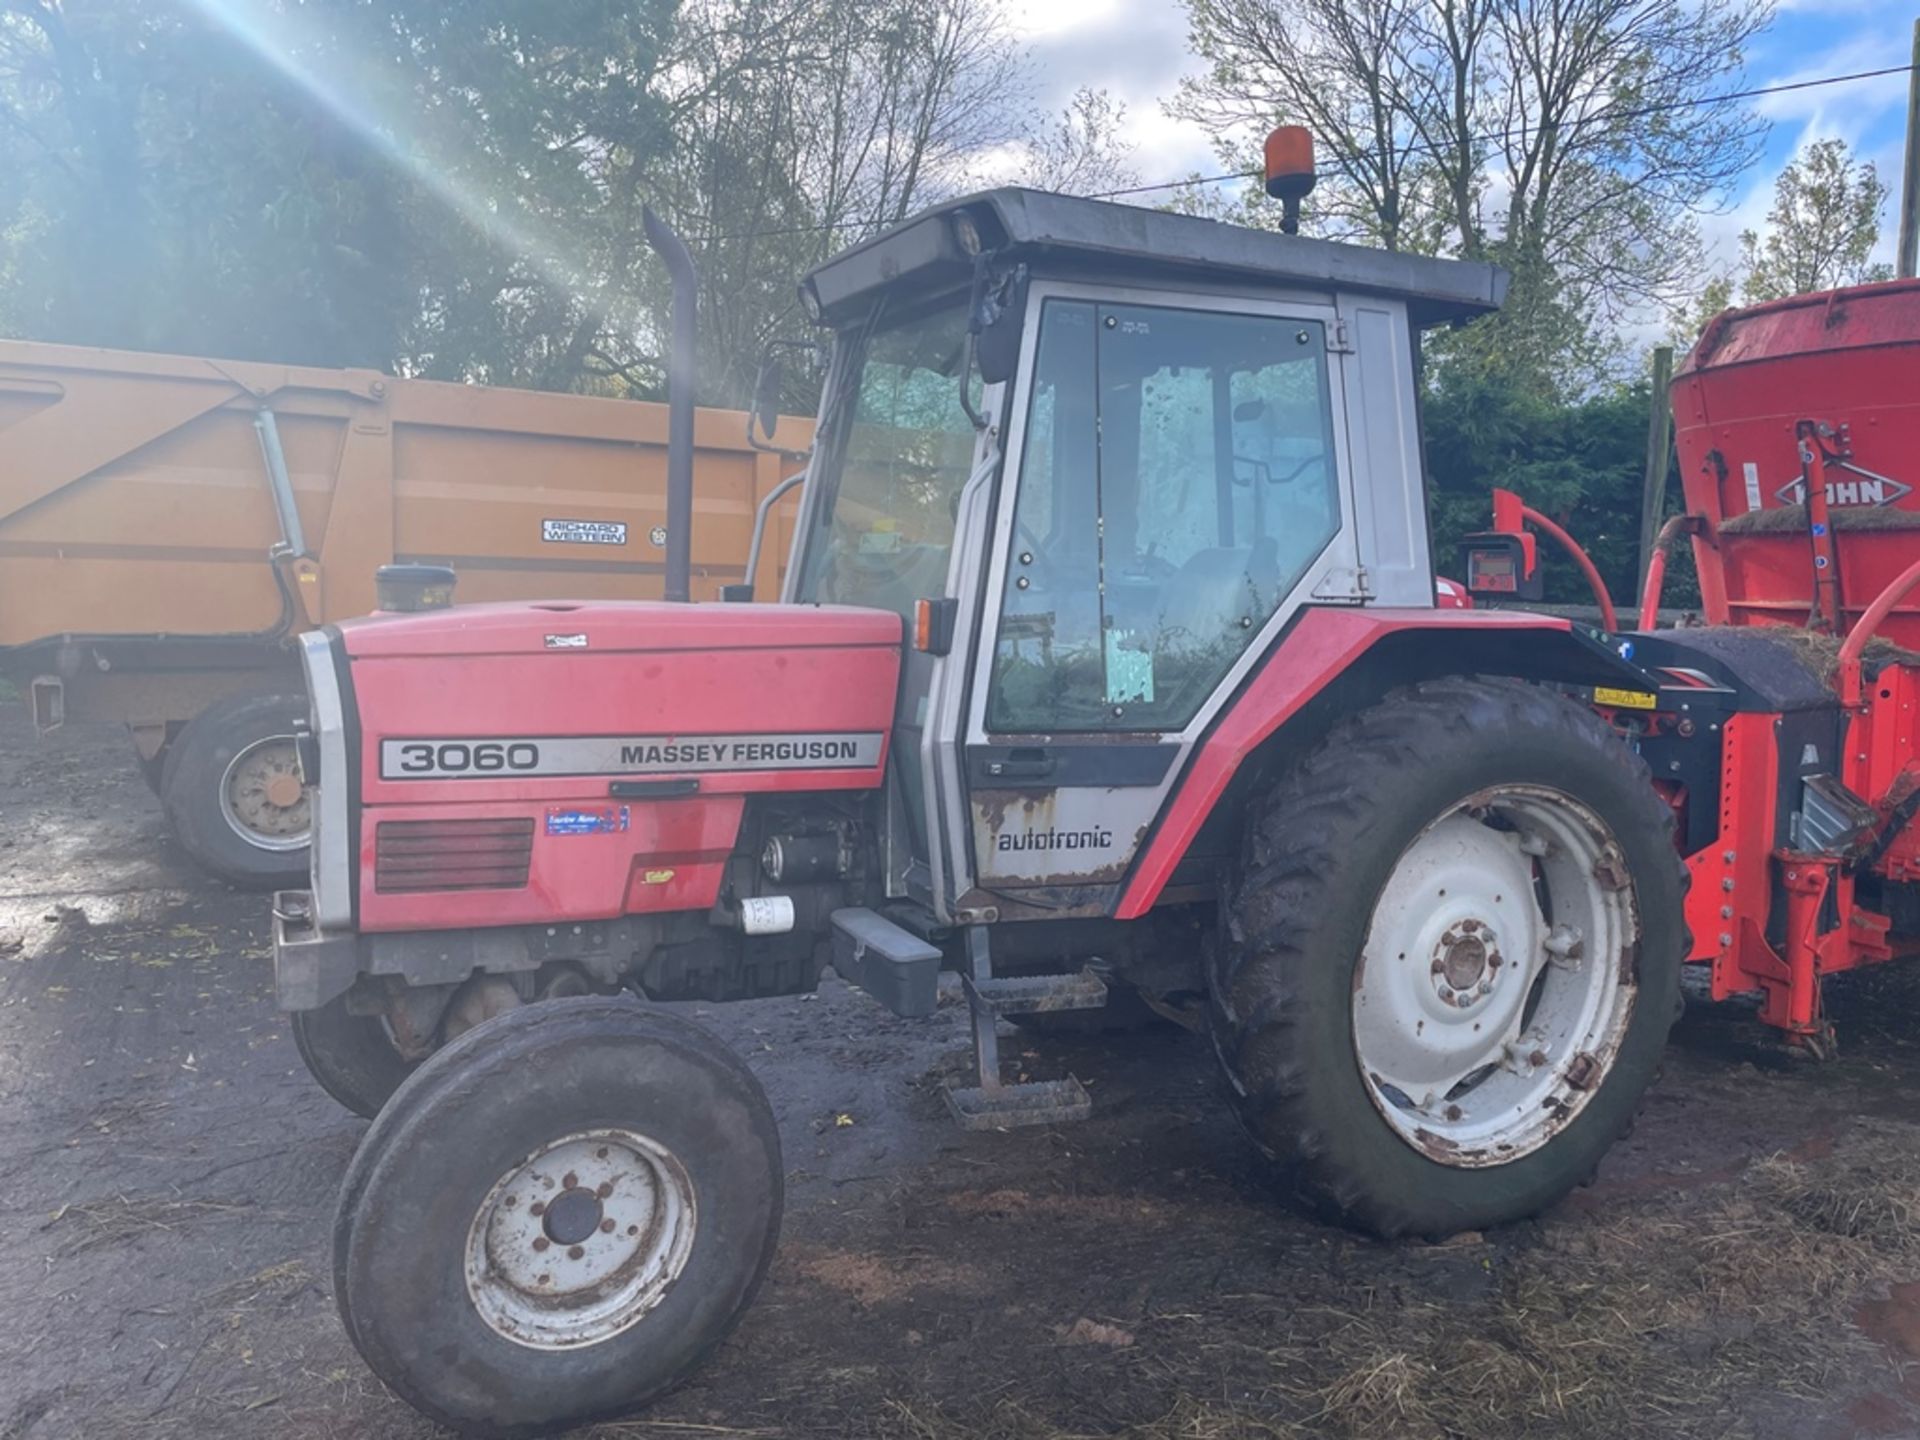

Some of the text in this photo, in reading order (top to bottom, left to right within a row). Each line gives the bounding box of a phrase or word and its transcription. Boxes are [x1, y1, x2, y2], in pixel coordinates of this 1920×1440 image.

[549, 531, 623, 542] WESTERN
[551, 522, 619, 533] RICHARD
[401, 743, 539, 772] 3060
[621, 742, 857, 764] MASSEY FERGUSON
[999, 825, 1112, 851] autotronic
